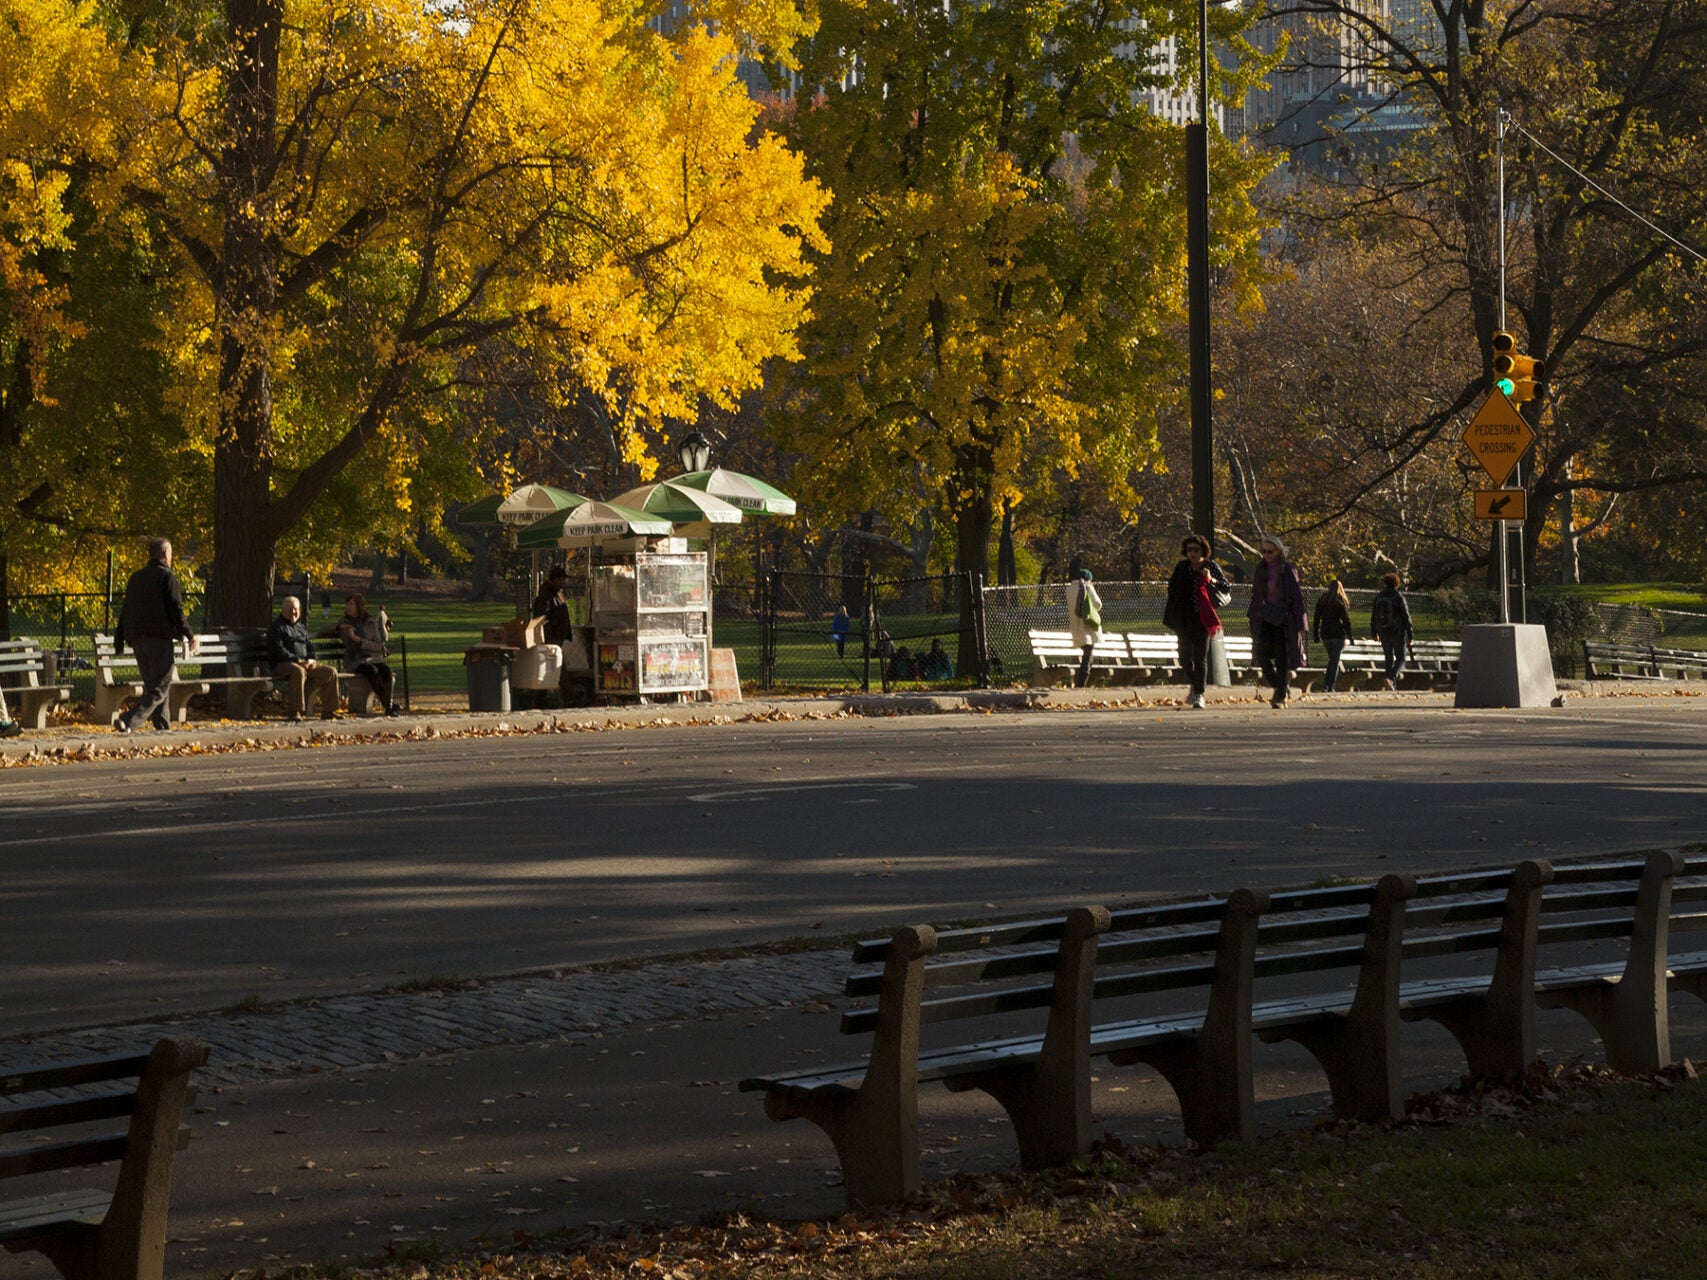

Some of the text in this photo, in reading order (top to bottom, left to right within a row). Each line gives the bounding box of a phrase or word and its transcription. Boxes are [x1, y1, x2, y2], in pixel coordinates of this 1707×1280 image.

[1474, 424, 1521, 437] PEDESTRIAN
[1479, 442, 1517, 454] CROSSING
[743, 498, 761, 509] CLEAN
[502, 512, 516, 522] KEEP
[518, 512, 534, 521] PARK
[570, 524, 624, 537] KEEP PARK CLEAN
[612, 660, 625, 674] 4
[603, 670, 633, 689] NUTS
